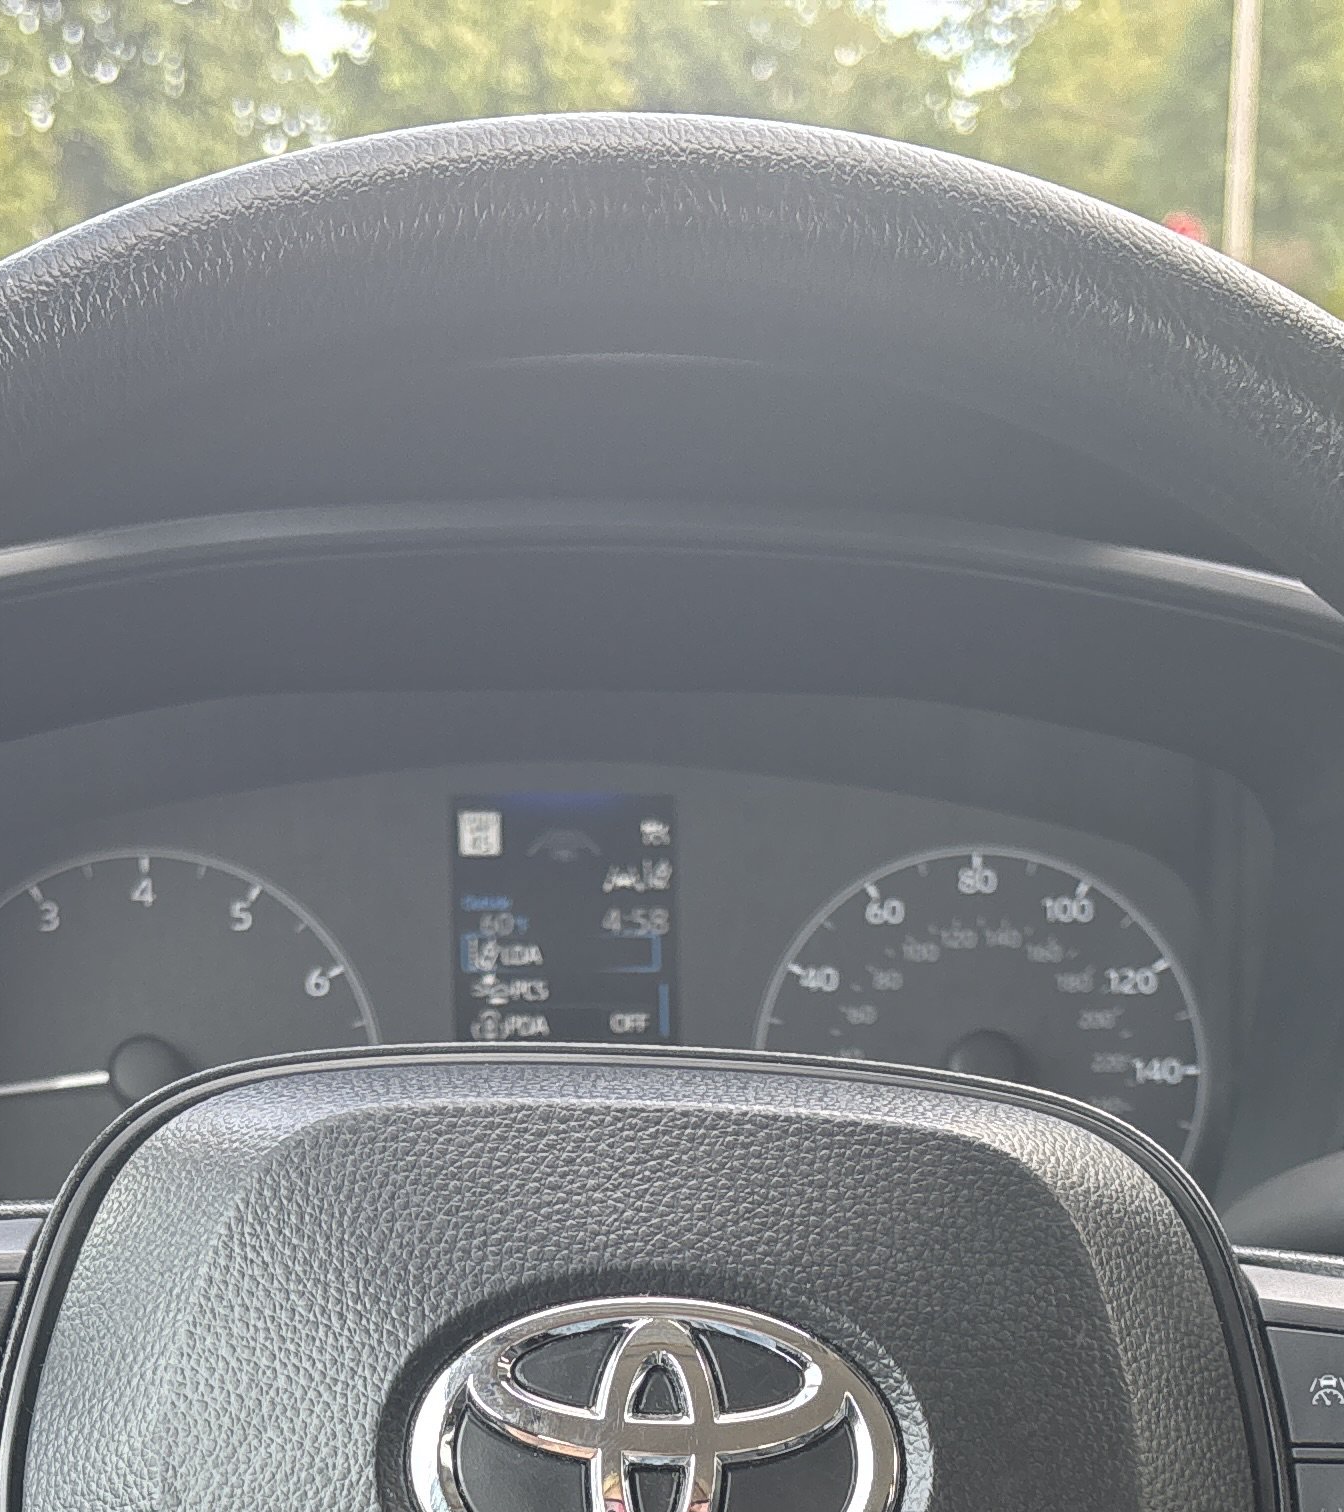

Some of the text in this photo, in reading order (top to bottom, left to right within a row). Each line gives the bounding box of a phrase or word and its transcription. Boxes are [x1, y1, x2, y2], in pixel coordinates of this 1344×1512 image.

[131, 878, 156, 906] 4
[957, 867, 998, 894] 80
[37, 903, 61, 933] 3
[229, 903, 253, 932] 5
[864, 897, 906, 925] 60
[1042, 896, 1095, 923] 100
[304, 966, 330, 997] 6
[798, 965, 840, 992] 40
[1105, 967, 1158, 995] 120
[1132, 1057, 1183, 1085] 140
